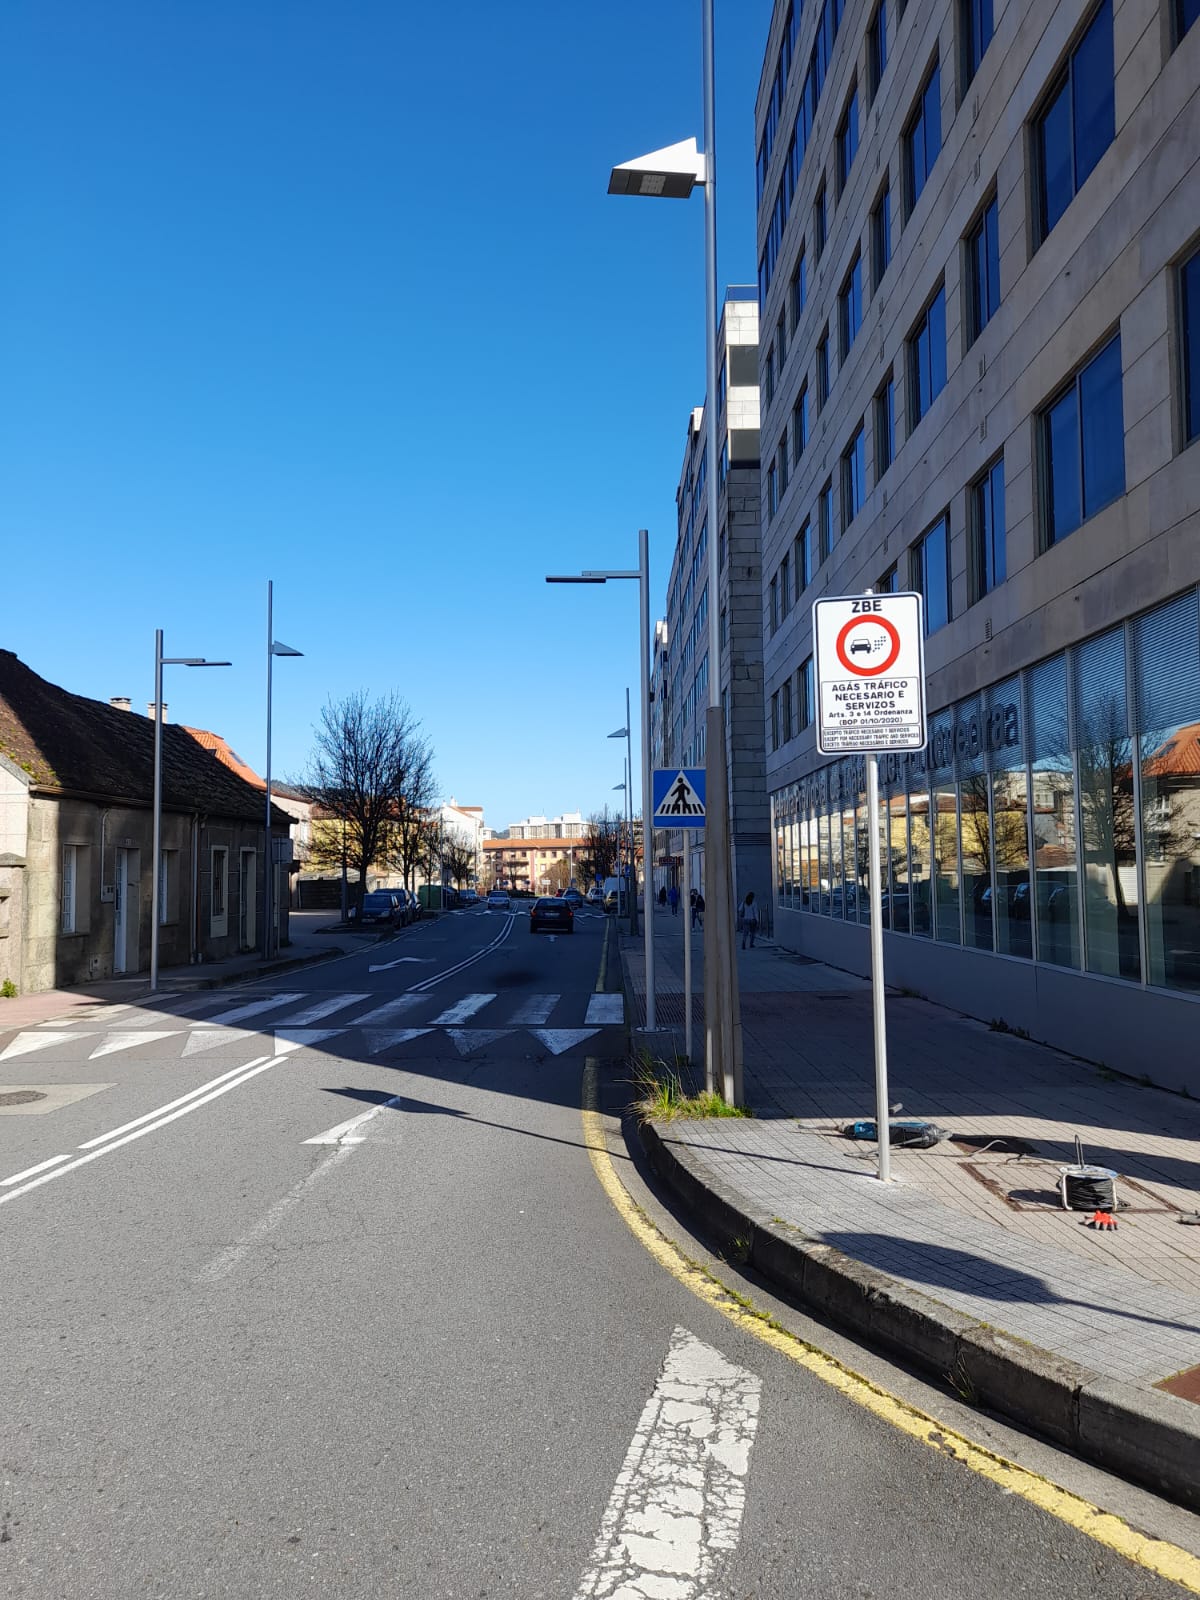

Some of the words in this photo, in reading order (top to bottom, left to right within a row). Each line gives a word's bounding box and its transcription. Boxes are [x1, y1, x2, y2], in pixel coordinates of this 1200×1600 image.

[851, 600, 883, 613] ZBE
[832, 682, 860, 692] AGÁS
[864, 680, 908, 690] TRÁFICO
[835, 691, 895, 701] NECESARIO
[898, 690, 905, 698] E
[845, 700, 896, 710] SERVIZOS
[860, 716, 903, 724] 01/10/2020)
